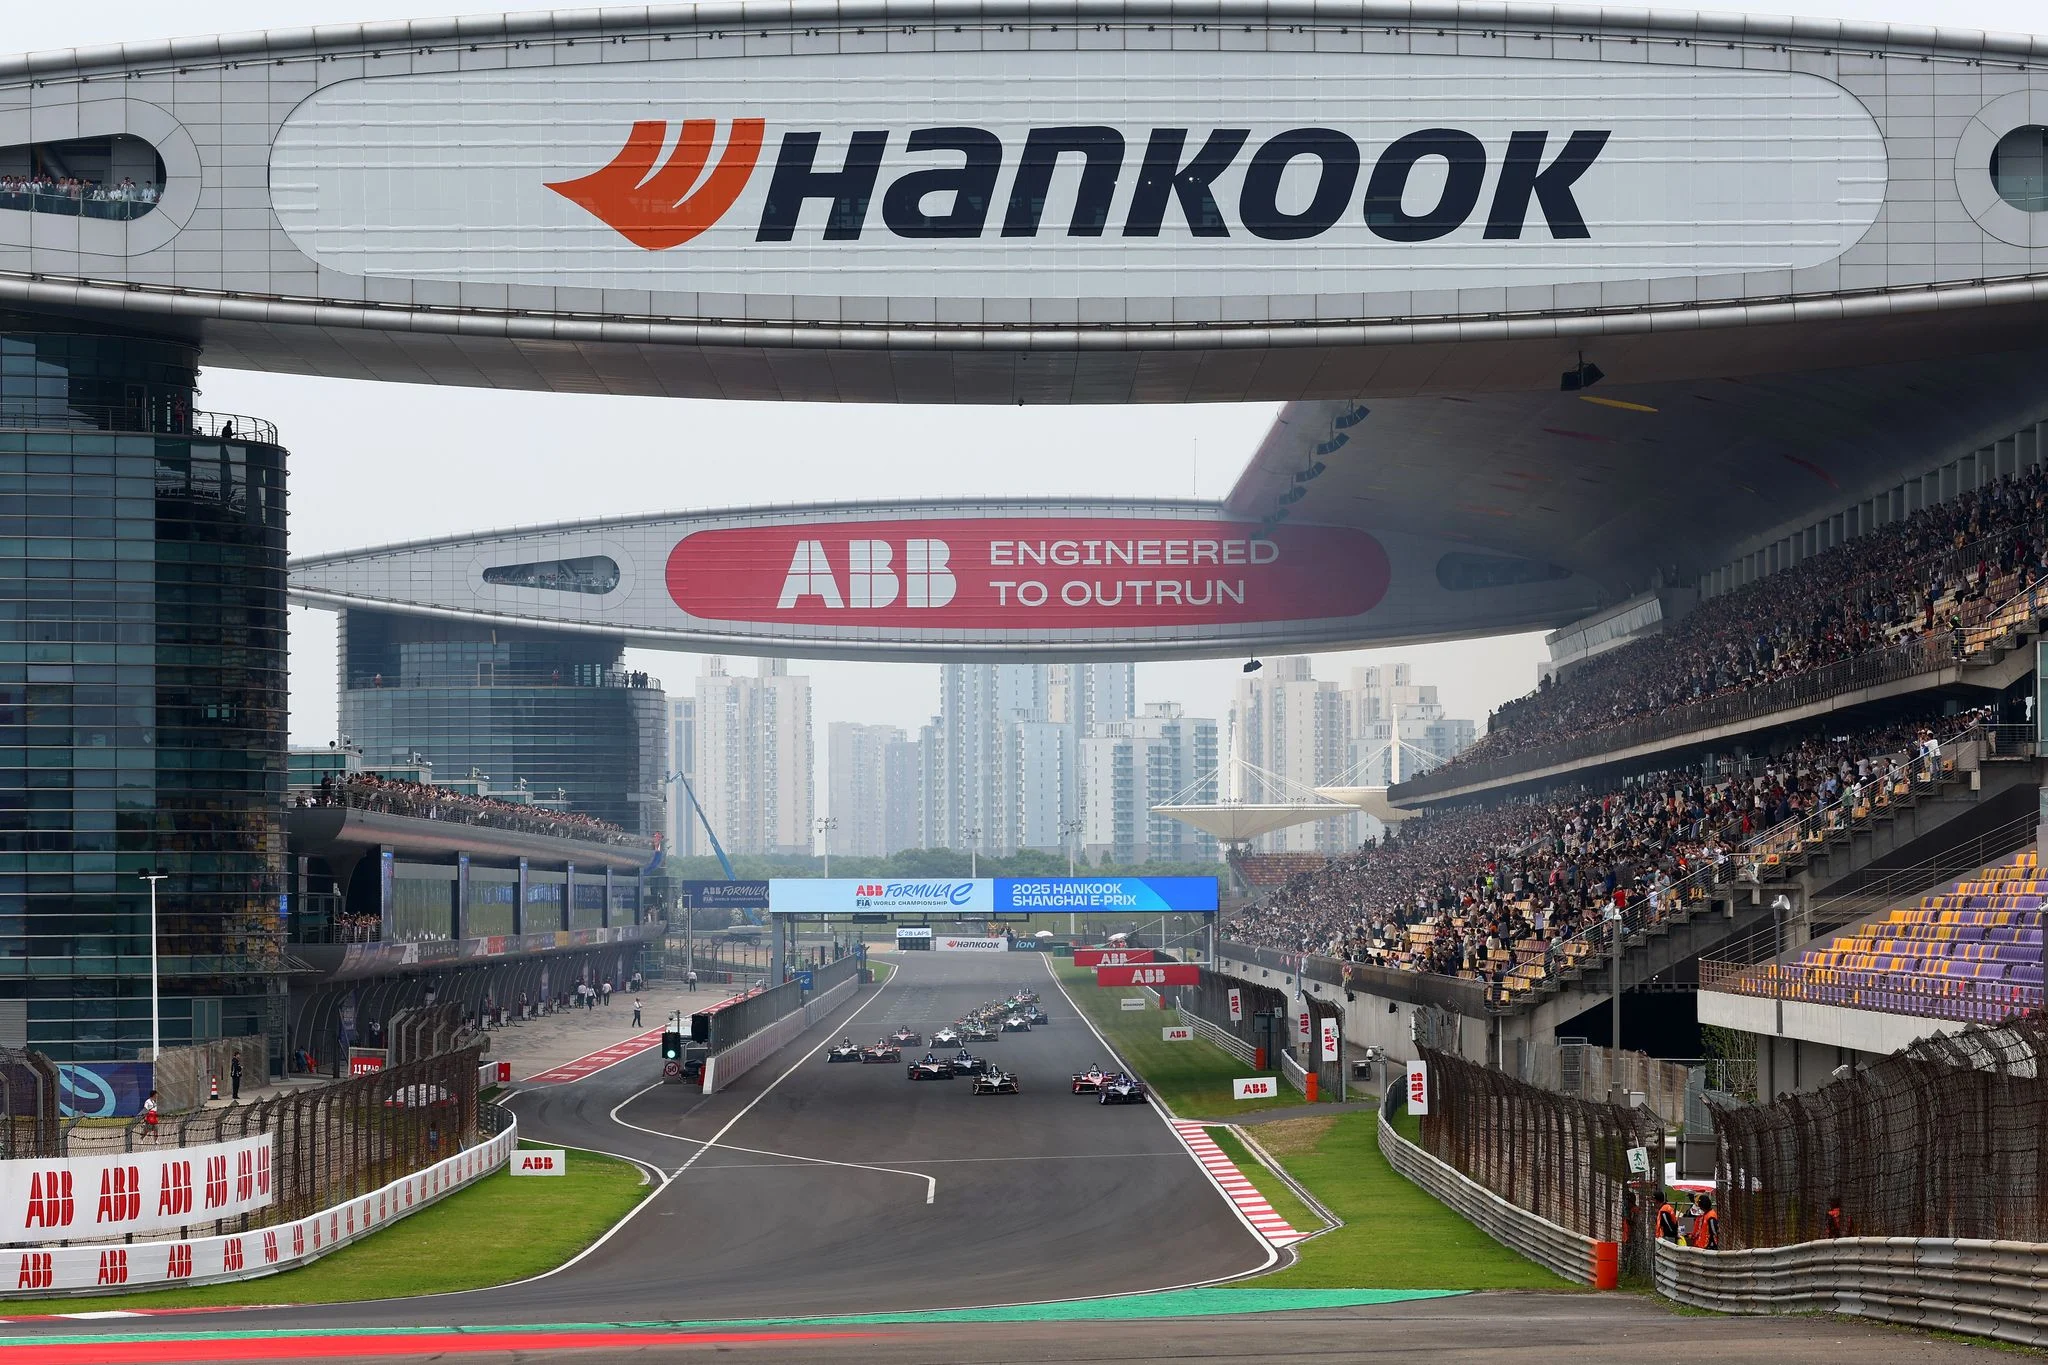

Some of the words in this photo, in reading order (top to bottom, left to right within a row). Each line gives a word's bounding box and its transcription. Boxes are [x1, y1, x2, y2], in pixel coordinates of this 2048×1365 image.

[990, 540, 1280, 565] ENGINEERED
[776, 539, 957, 608] ABB
[989, 580, 1048, 606] TO
[1061, 580, 1244, 606] OUTRUN
[856, 885, 883, 897] ABB
[884, 883, 951, 898] FORMULA
[1012, 884, 1051, 895] 2025
[1053, 883, 1122, 895] HANKOOK
[1012, 895, 1088, 906] SHANGHAI
[1090, 895, 1137, 906] E-PRIX
[1132, 969, 1166, 984] ABB
[1231, 995, 1240, 1014] ABB
[1300, 1013, 1310, 1035] ABB
[667, 1065, 677, 1073] 50
[1243, 1083, 1268, 1094] ABB
[1411, 1072, 1424, 1104] ABB
[522, 1157, 554, 1170] ABB
[25, 1171, 75, 1229] ABB
[97, 1166, 141, 1224] ABB
[158, 1160, 193, 1217] ABB
[205, 1155, 228, 1210] ABB
[236, 1150, 253, 1203] ABB
[18, 1252, 53, 1289] ABB
[98, 1249, 128, 1285] ABB
[167, 1244, 193, 1279] ABB
[223, 1238, 244, 1273] ABB
[264, 1231, 279, 1264] ABB
